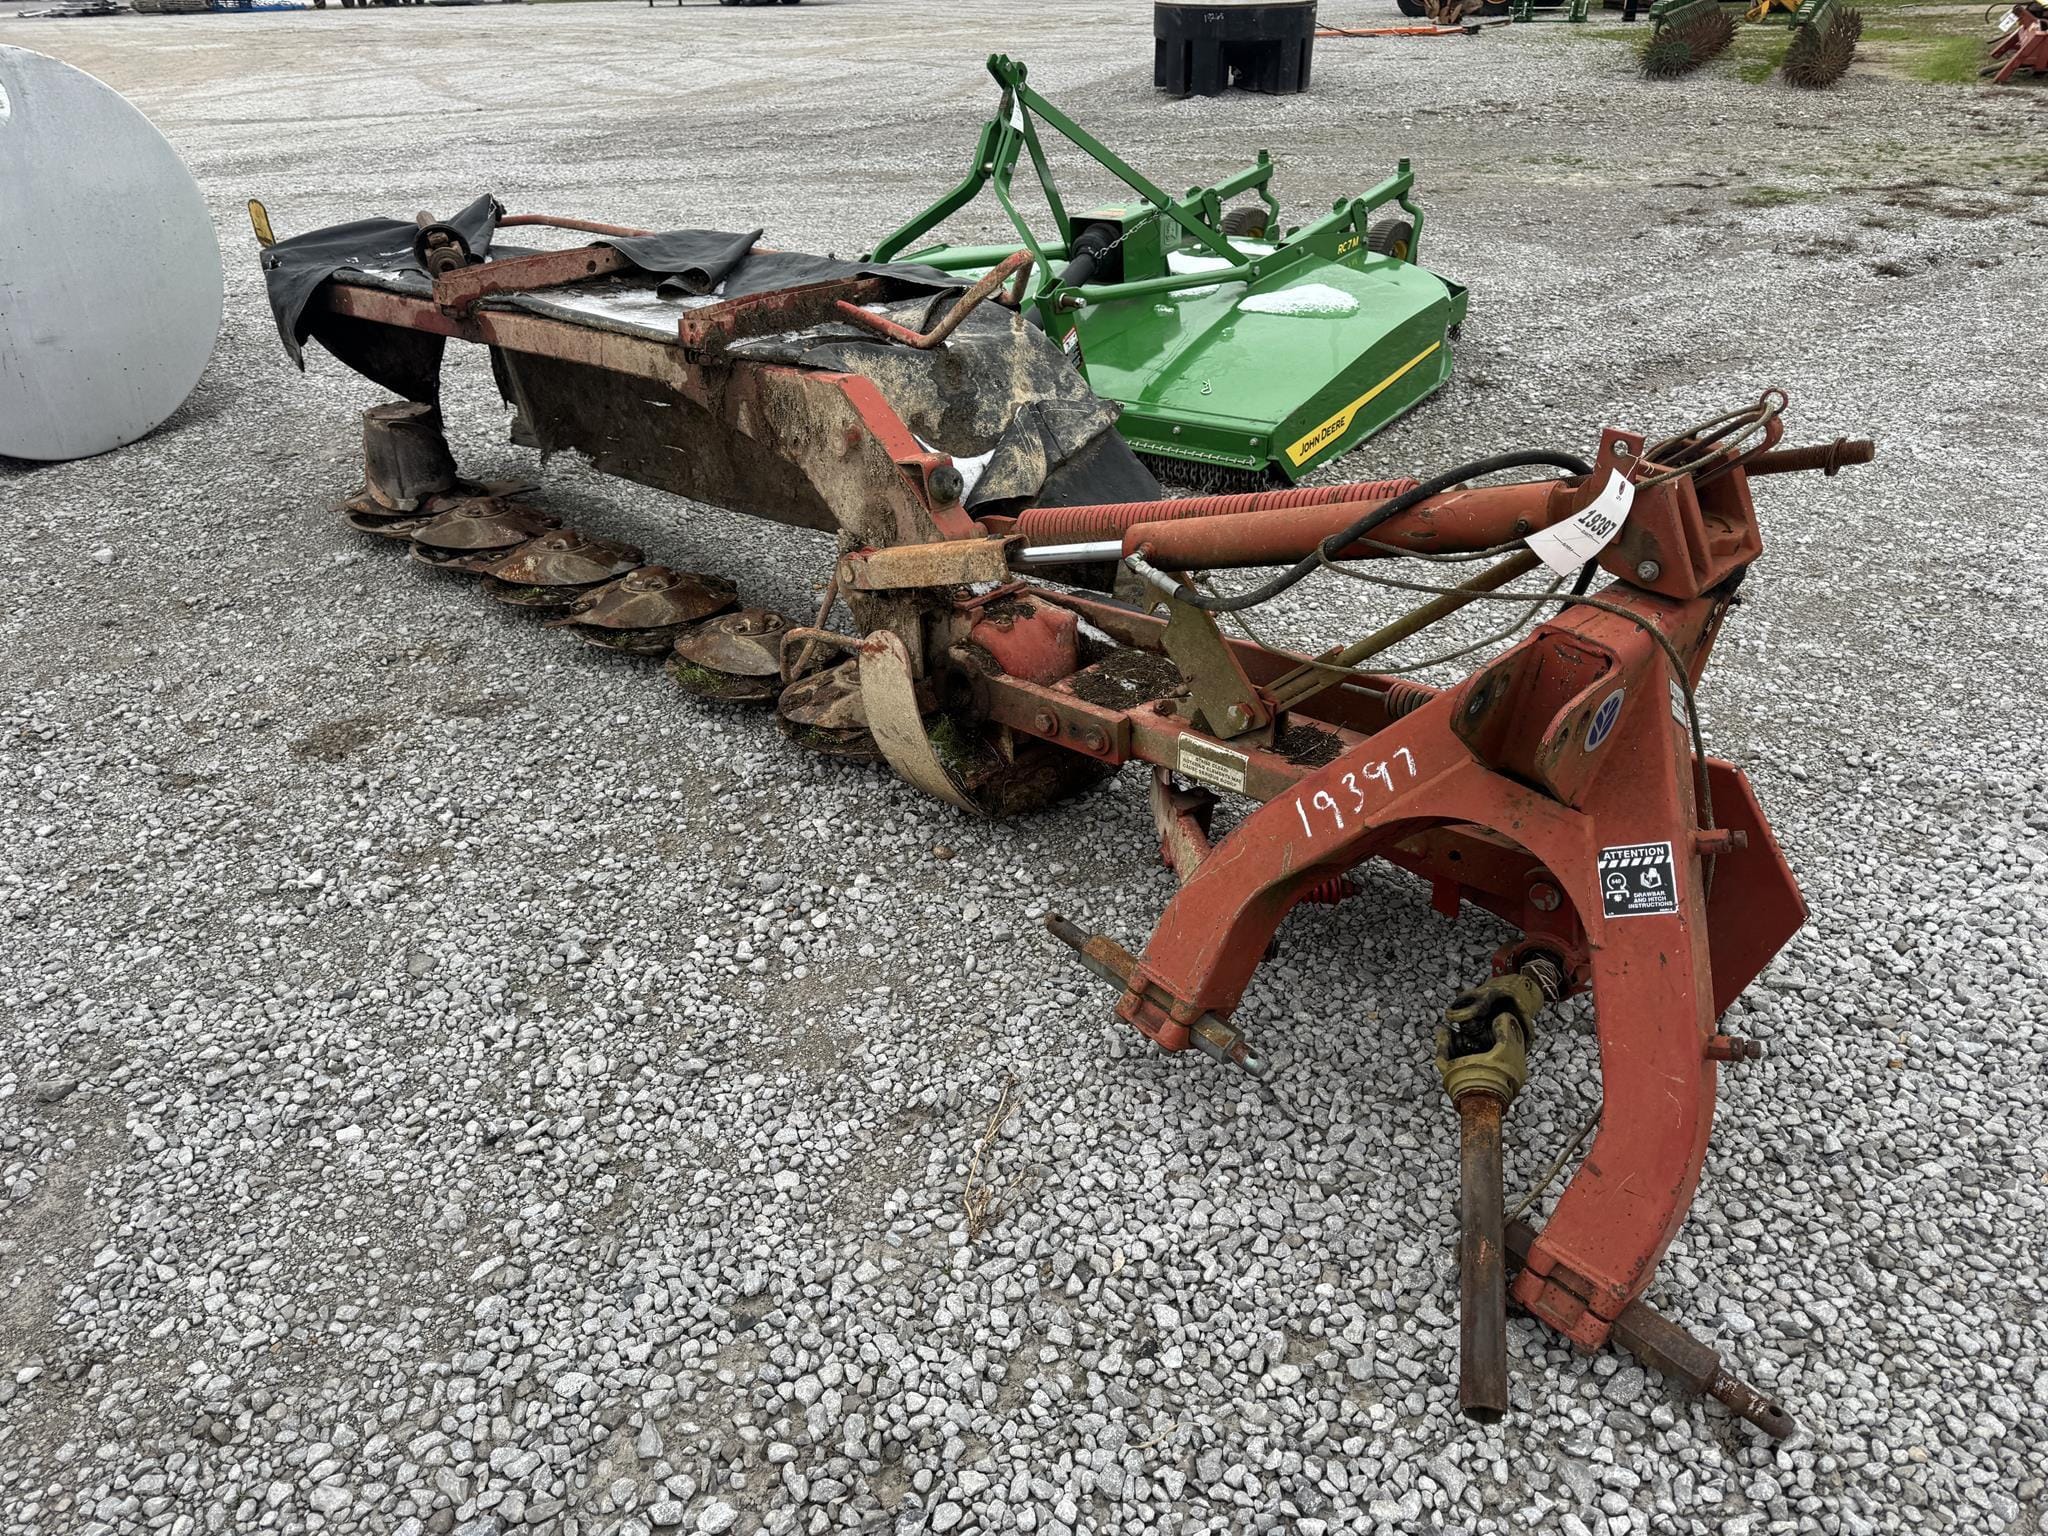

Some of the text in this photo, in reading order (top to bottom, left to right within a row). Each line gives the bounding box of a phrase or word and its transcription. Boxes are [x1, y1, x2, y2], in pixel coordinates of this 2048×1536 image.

[1337, 235, 1360, 255] RC7M
[1299, 416, 1346, 457] JOHN DEERE
[1578, 509, 1617, 539] 19397
[1295, 746, 1417, 838] 19397
[1603, 846, 1664, 860] ATTENTION
[1628, 901, 1673, 909] INSTRUCTIONS
